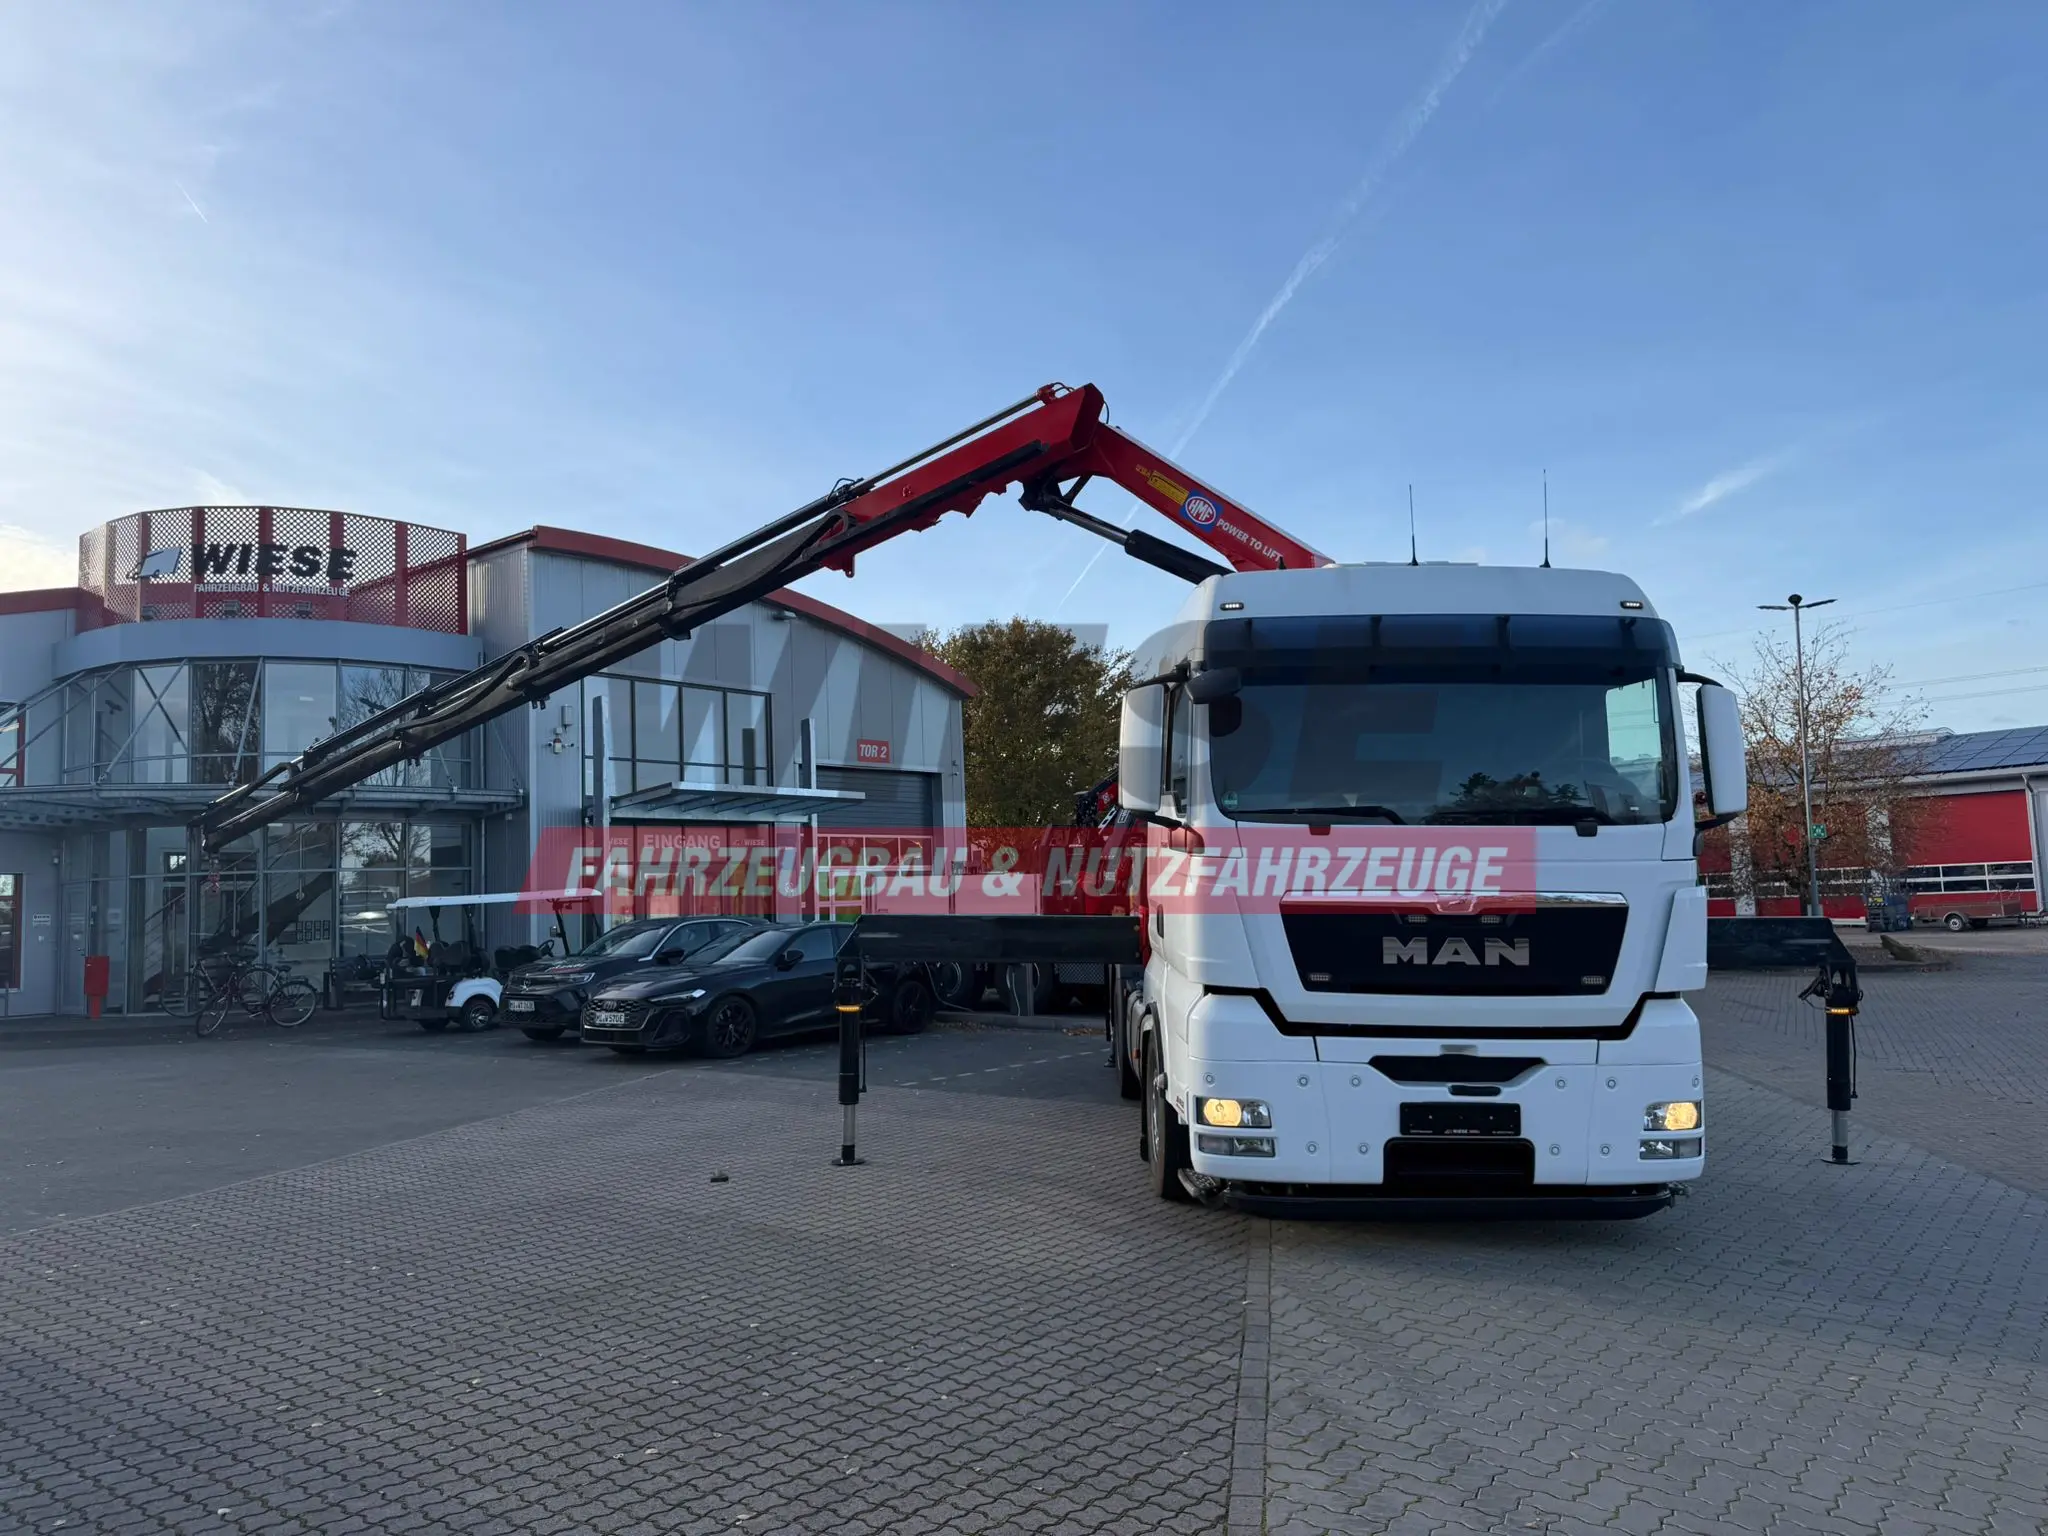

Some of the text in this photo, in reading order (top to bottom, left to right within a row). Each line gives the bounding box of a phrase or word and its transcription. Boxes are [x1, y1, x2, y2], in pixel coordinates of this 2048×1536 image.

[1188, 499, 1213, 521] HMF
[1216, 519, 1283, 562] POWER TO LIFT
[192, 543, 357, 580] WIESE
[194, 583, 350, 597] FAHRZEUGBAU & NUTZFAHRZEUGE
[859, 744, 888, 758] TOR 2
[643, 834, 721, 849] EINGANG
[1382, 937, 1530, 966] MAN
